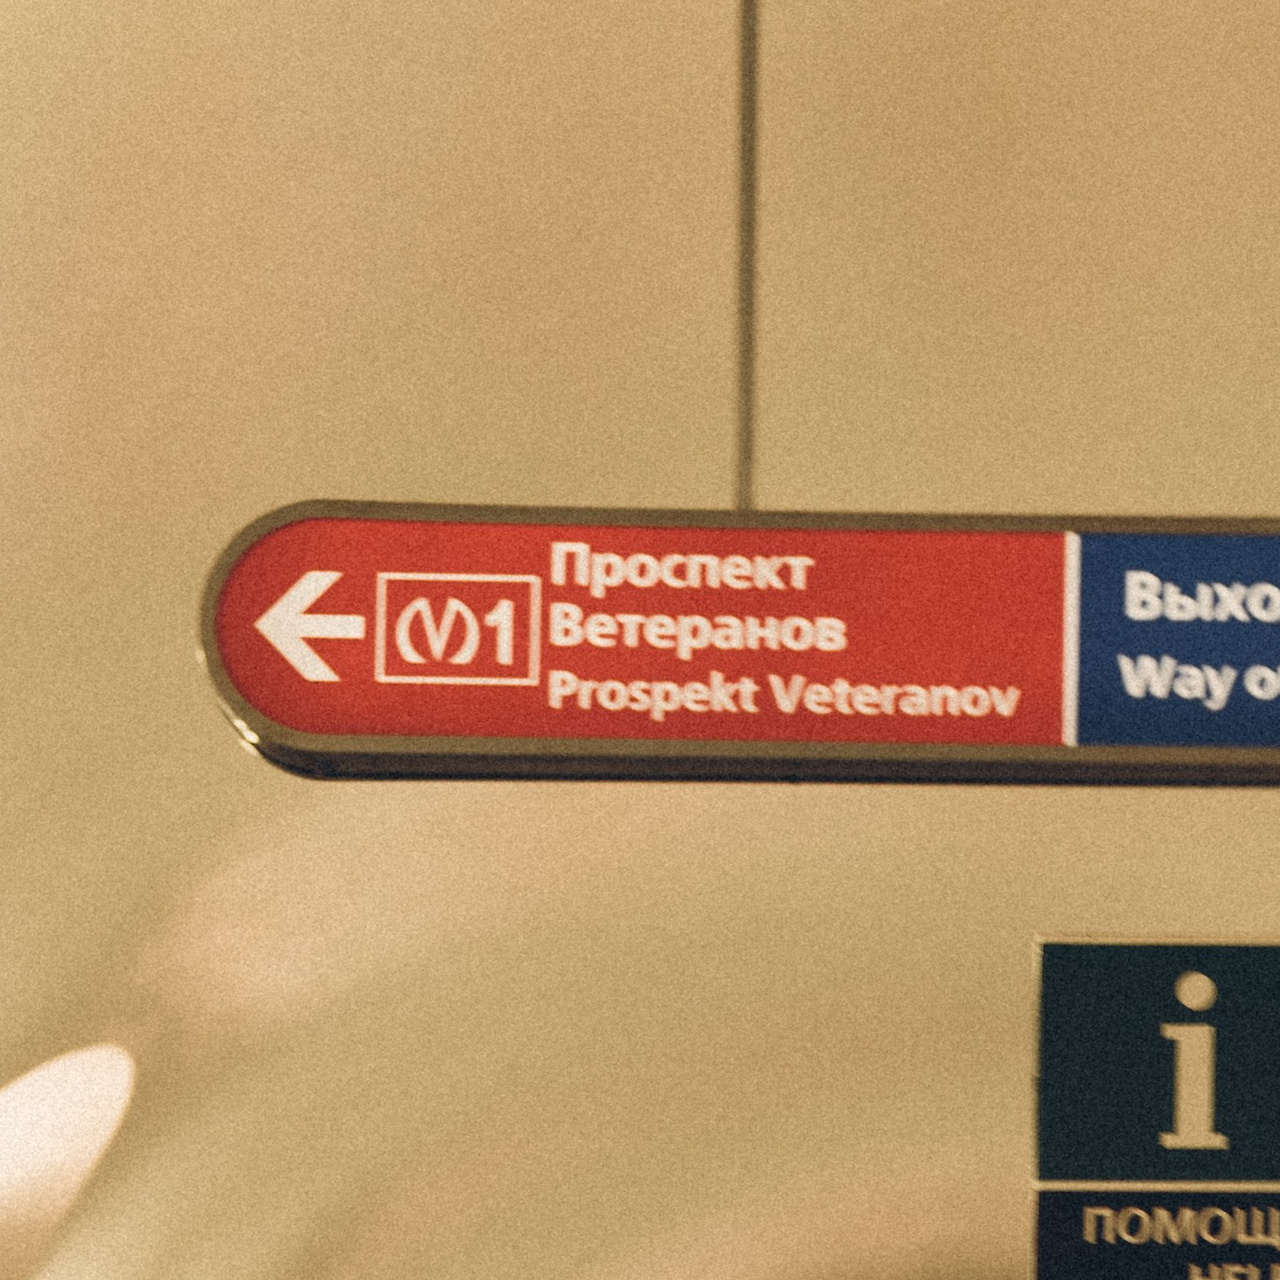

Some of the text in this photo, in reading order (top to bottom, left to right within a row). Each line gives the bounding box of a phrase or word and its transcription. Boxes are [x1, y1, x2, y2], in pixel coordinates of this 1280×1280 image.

[550, 541, 816, 598] Проспект
[550, 602, 848, 662] Ветеранов
[548, 669, 1021, 722] Prospekt Veteranov
[1116, 654, 1237, 712] Way
